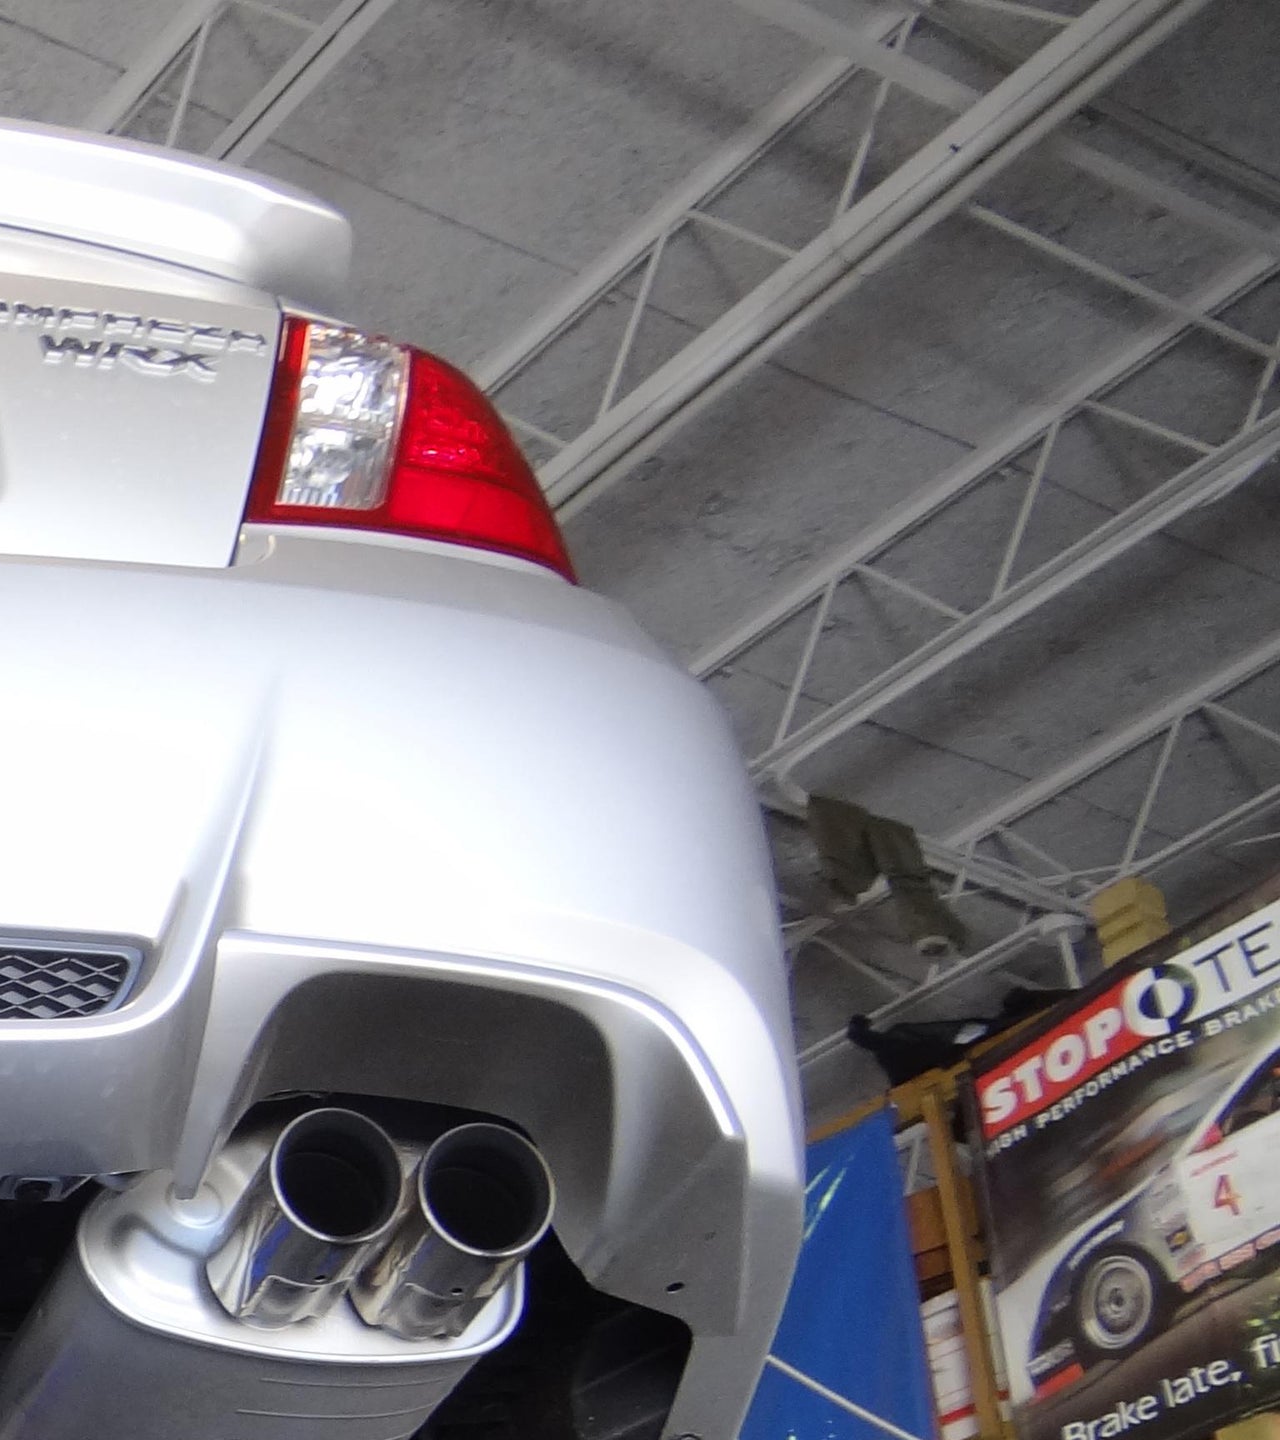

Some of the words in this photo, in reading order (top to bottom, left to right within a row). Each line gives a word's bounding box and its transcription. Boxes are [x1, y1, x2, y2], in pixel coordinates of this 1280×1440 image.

[39, 334, 218, 384] WRX
[1034, 1028, 1195, 1130] PERFORMANCE
[1212, 1174, 1241, 1217] 4
[1161, 1357, 1244, 1410] late,
